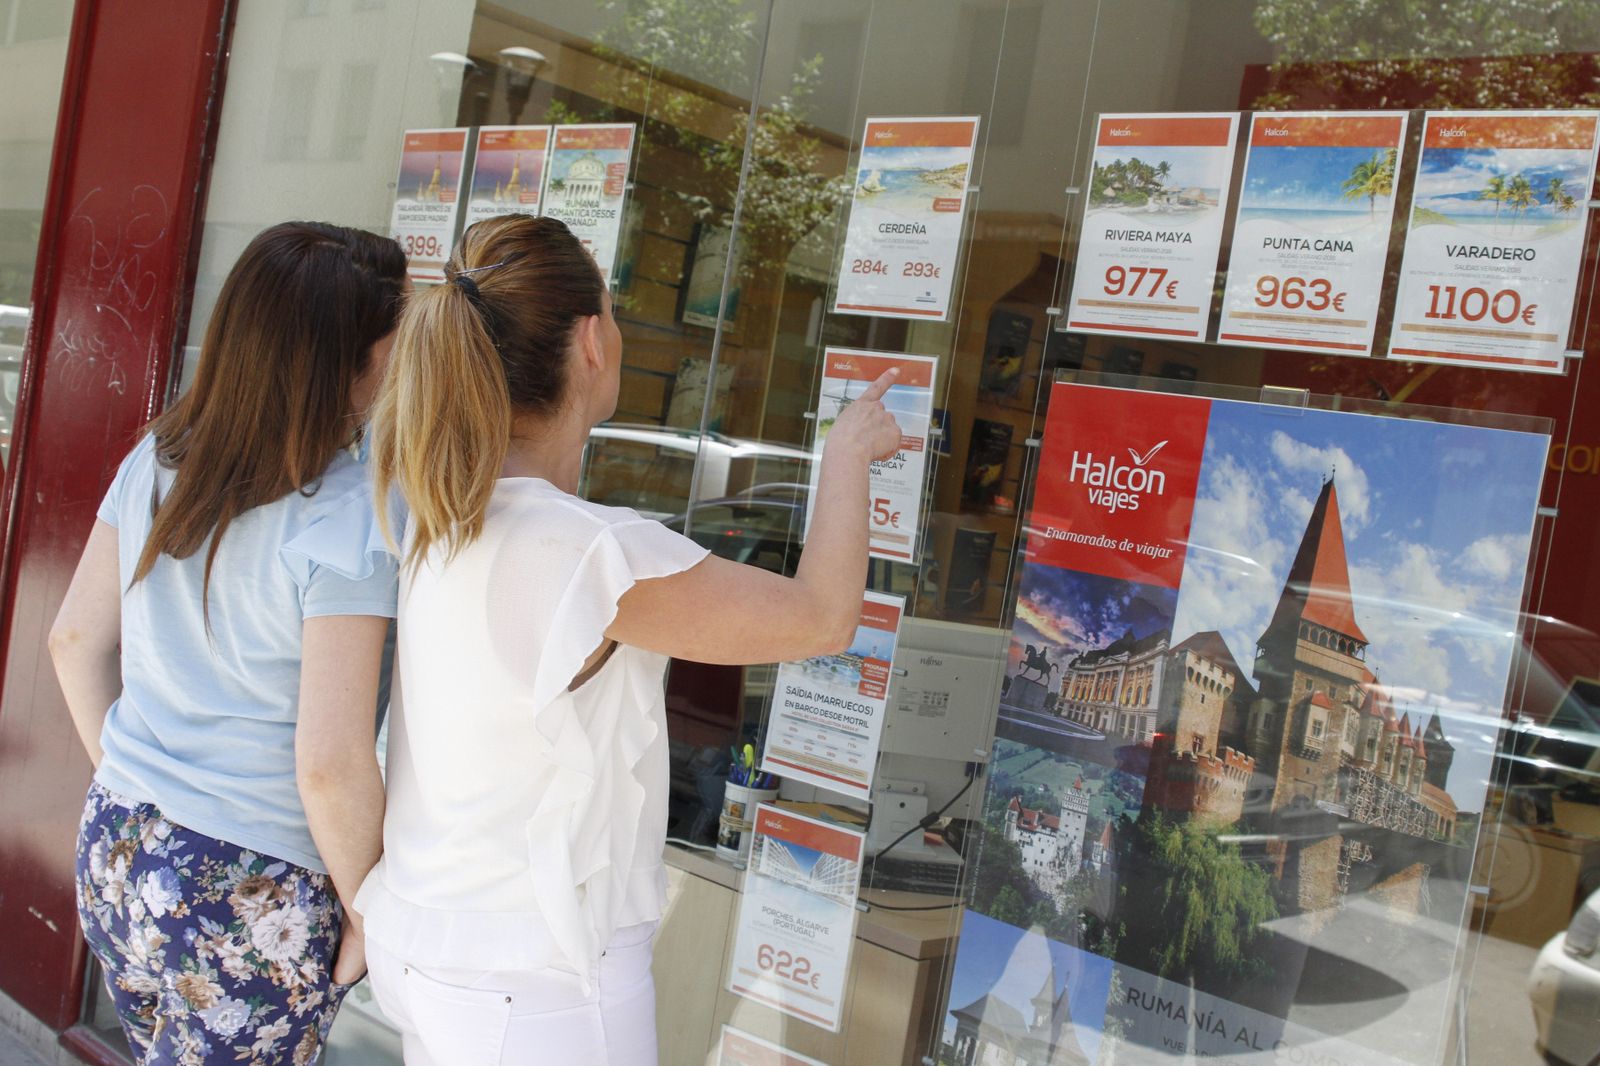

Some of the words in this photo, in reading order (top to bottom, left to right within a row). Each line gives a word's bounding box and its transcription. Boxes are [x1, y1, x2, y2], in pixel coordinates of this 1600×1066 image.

[878, 222, 927, 235] CERDEÑA
[1105, 229, 1153, 242] RIVIERA
[1155, 231, 1192, 244] MAYA
[1263, 237, 1311, 251] PUNTA
[1313, 239, 1354, 253] CANA
[1446, 244, 1536, 262] VARADERO
[852, 258, 889, 275] 284€
[902, 261, 940, 279] 293€
[1103, 265, 1179, 300] 977€
[1254, 274, 1347, 313] 963€
[1424, 284, 1538, 326] 1100€
[869, 460, 898, 470] ELGICA
[868, 497, 901, 529] 5€
[1088, 487, 1140, 514] viajes
[1045, 526, 1117, 550] Enamorados
[1118, 538, 1134, 553] de
[1136, 542, 1173, 560] viajar
[784, 699, 794, 709] EN
[794, 701, 819, 716] BARCO
[819, 708, 842, 722] DESDE
[842, 714, 870, 730] MOTRIL
[814, 692, 874, 717] (MARRUECOS)
[773, 918, 816, 939] (PORTUGAL)
[796, 917, 830, 936] ALGARVE
[756, 943, 821, 990] 622€
[1234, 1026, 1264, 1052] AL
